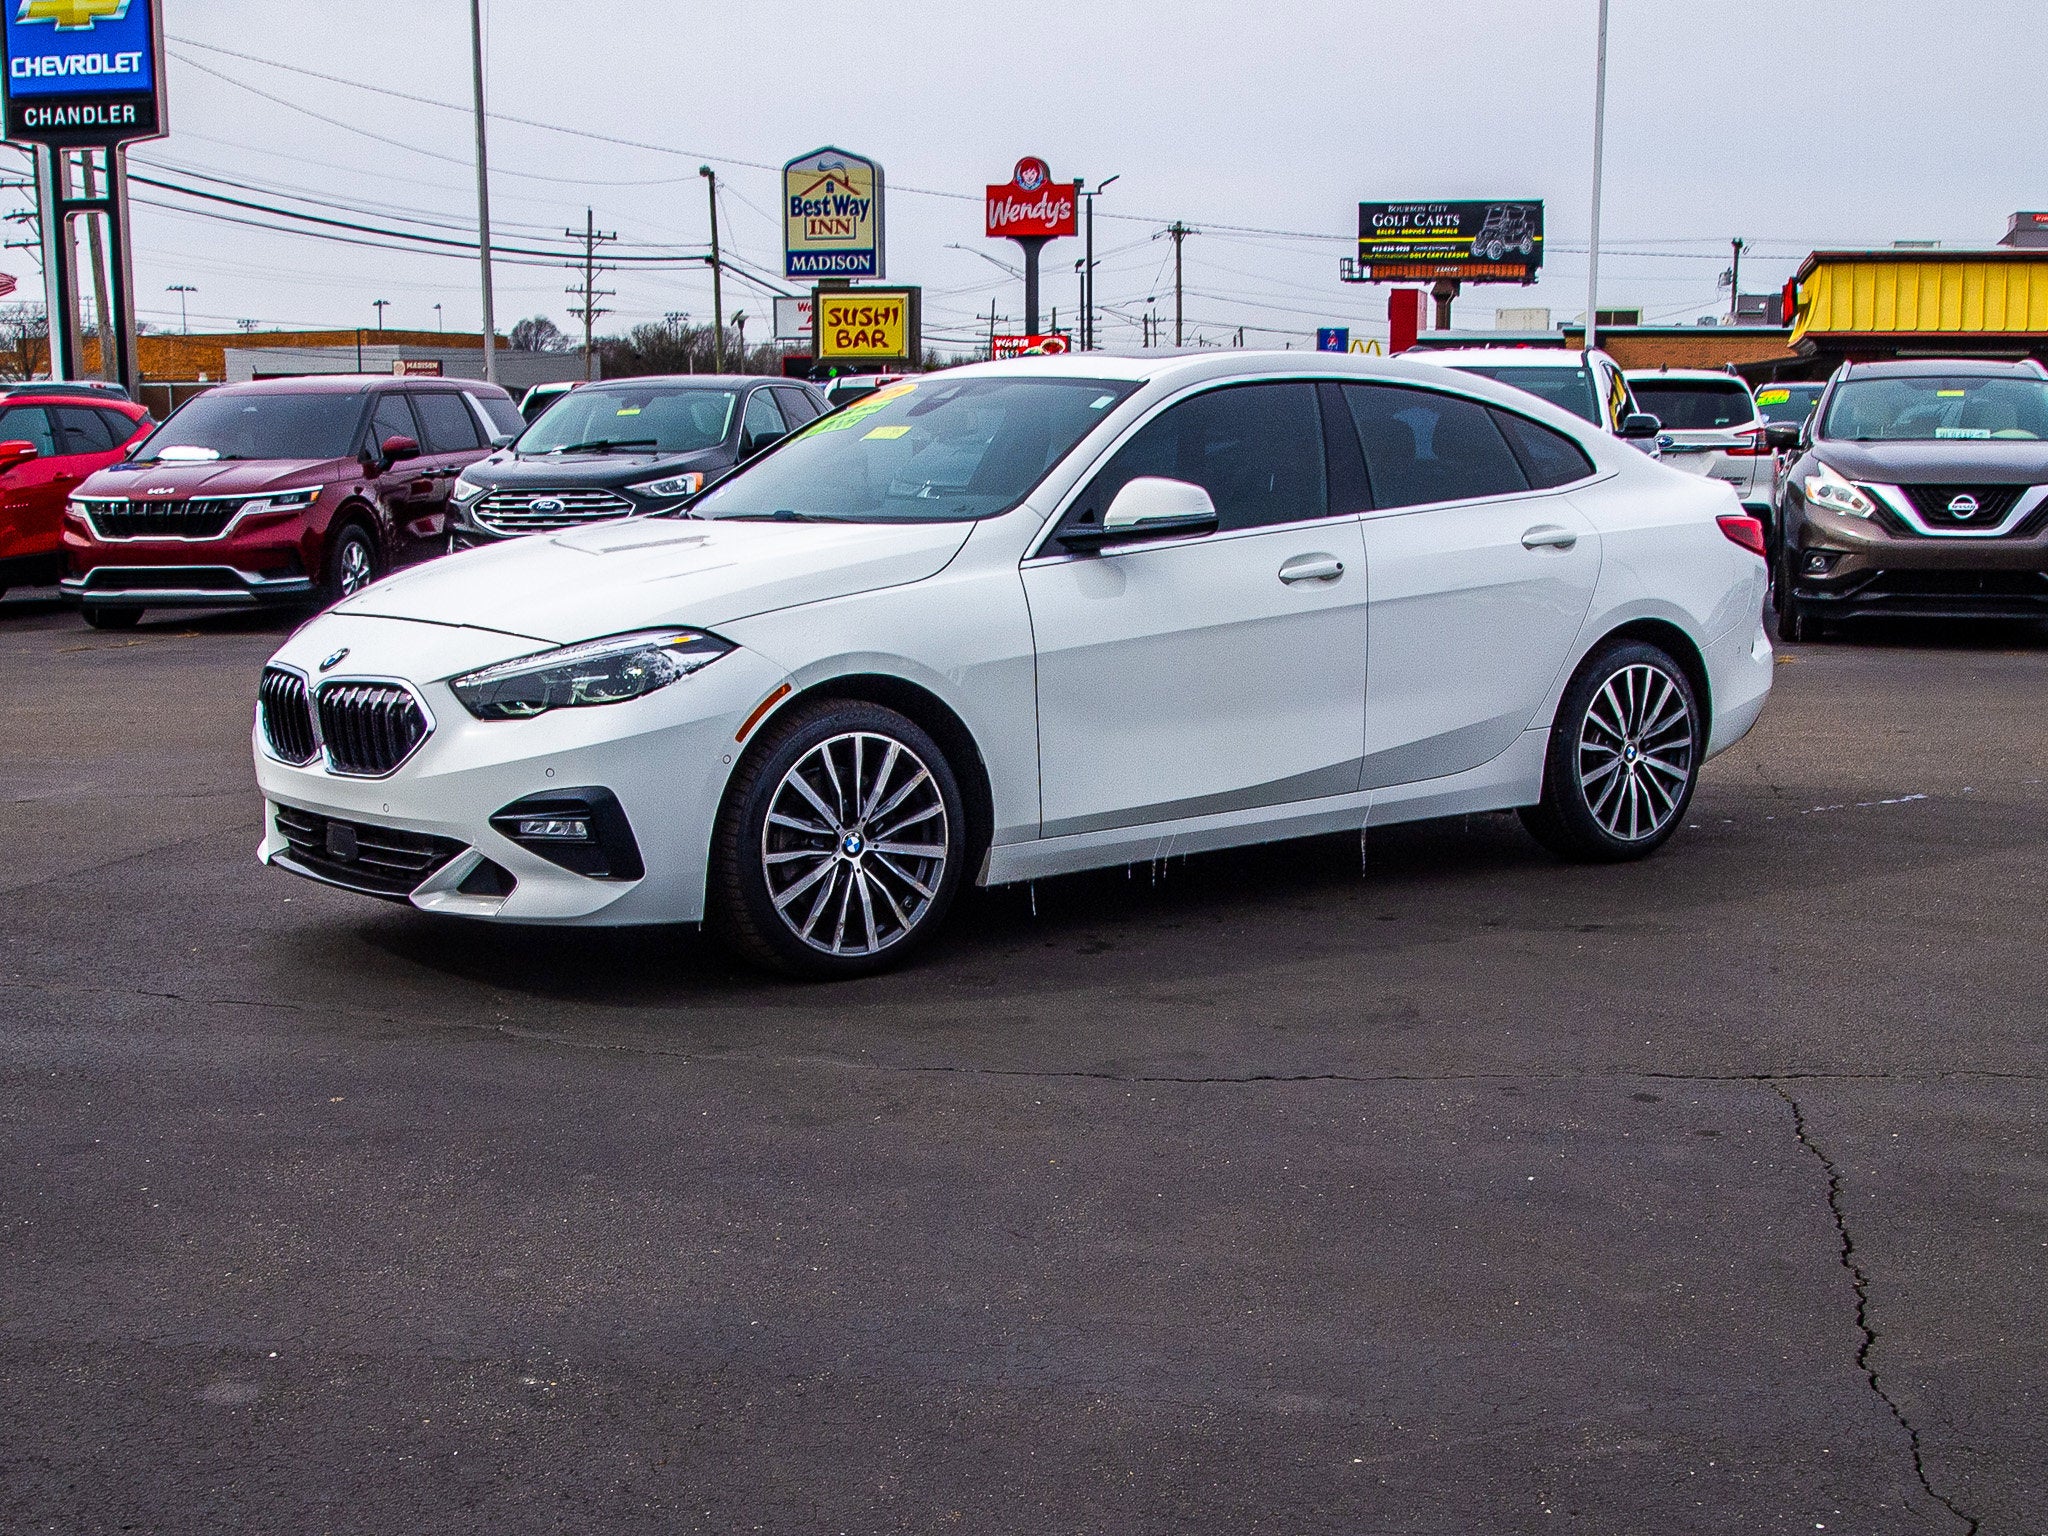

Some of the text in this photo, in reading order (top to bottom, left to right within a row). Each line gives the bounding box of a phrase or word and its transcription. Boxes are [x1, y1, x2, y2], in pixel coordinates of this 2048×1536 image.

[11, 51, 142, 78] CHEVROLET
[24, 105, 135, 127] CHANDLER
[989, 191, 1071, 230] Wendy's
[809, 219, 851, 235] INN
[791, 255, 871, 271] MADISON
[828, 307, 899, 327] SUSHI
[835, 329, 889, 349] BAR
